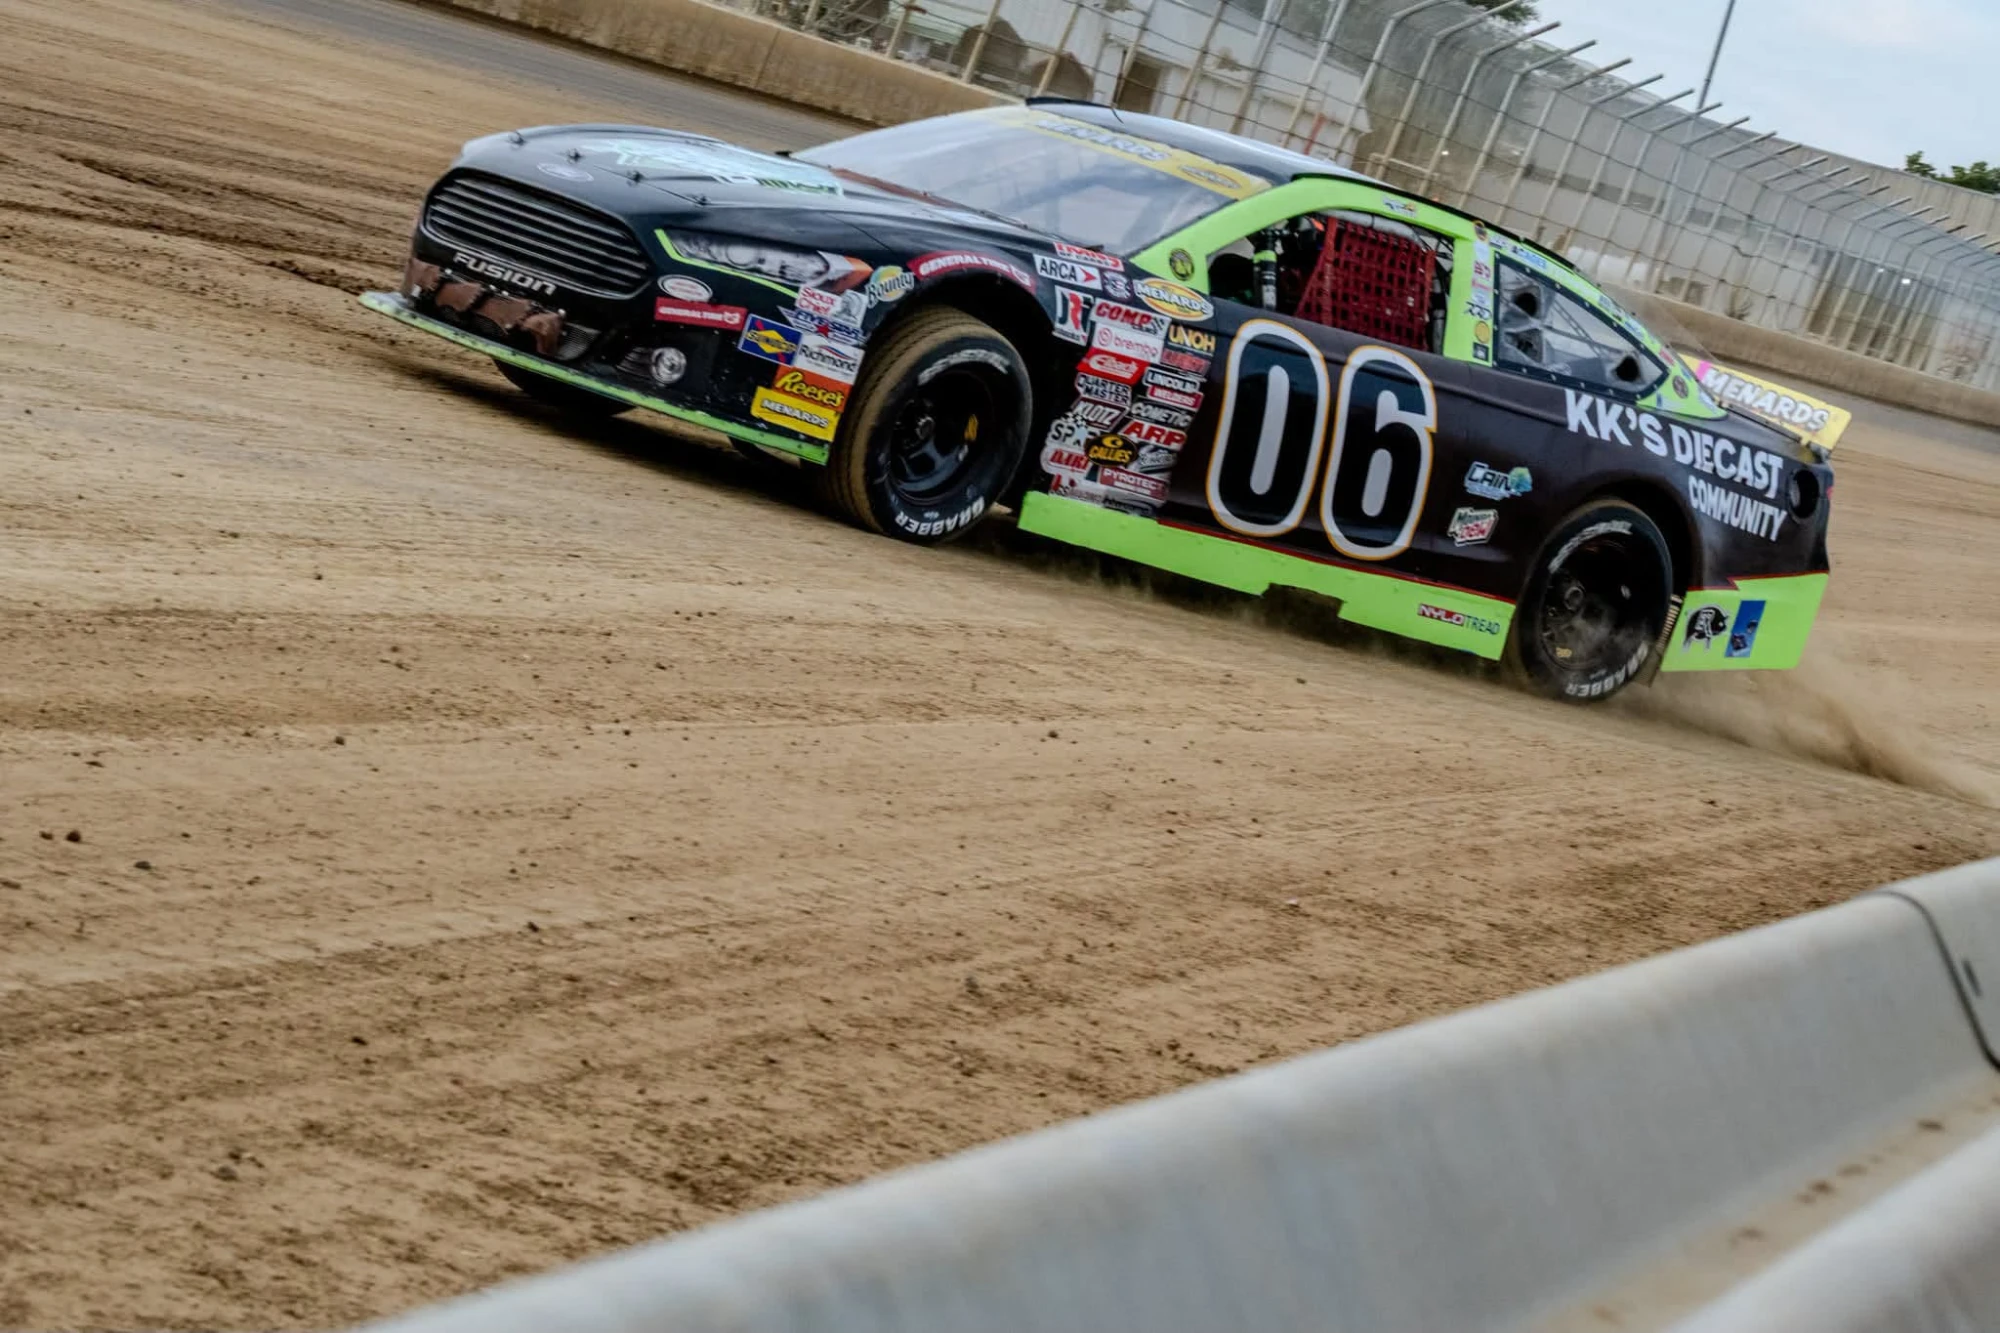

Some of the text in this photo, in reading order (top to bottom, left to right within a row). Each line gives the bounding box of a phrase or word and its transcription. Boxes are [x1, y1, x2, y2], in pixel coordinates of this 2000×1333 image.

[919, 255, 981, 275] GENERAL
[1040, 258, 1077, 282] ARCA
[803, 287, 835, 305] Sioux
[866, 272, 914, 307] Bounty
[1136, 282, 1212, 315] MENARDS
[1096, 302, 1151, 327] COMP
[1169, 325, 1215, 351] UNOH
[775, 371, 845, 407] Reese's
[1077, 374, 1130, 394] QUARTER
[1083, 385, 1129, 405] MASTER
[1702, 368, 1829, 431] MENARDS
[762, 399, 829, 429] MENARDS
[1122, 420, 1186, 447] ARP
[1206, 319, 1437, 561] 06
[1564, 389, 1784, 499] KK'S DIECAST
[1688, 475, 1787, 542] COMMUNITY
